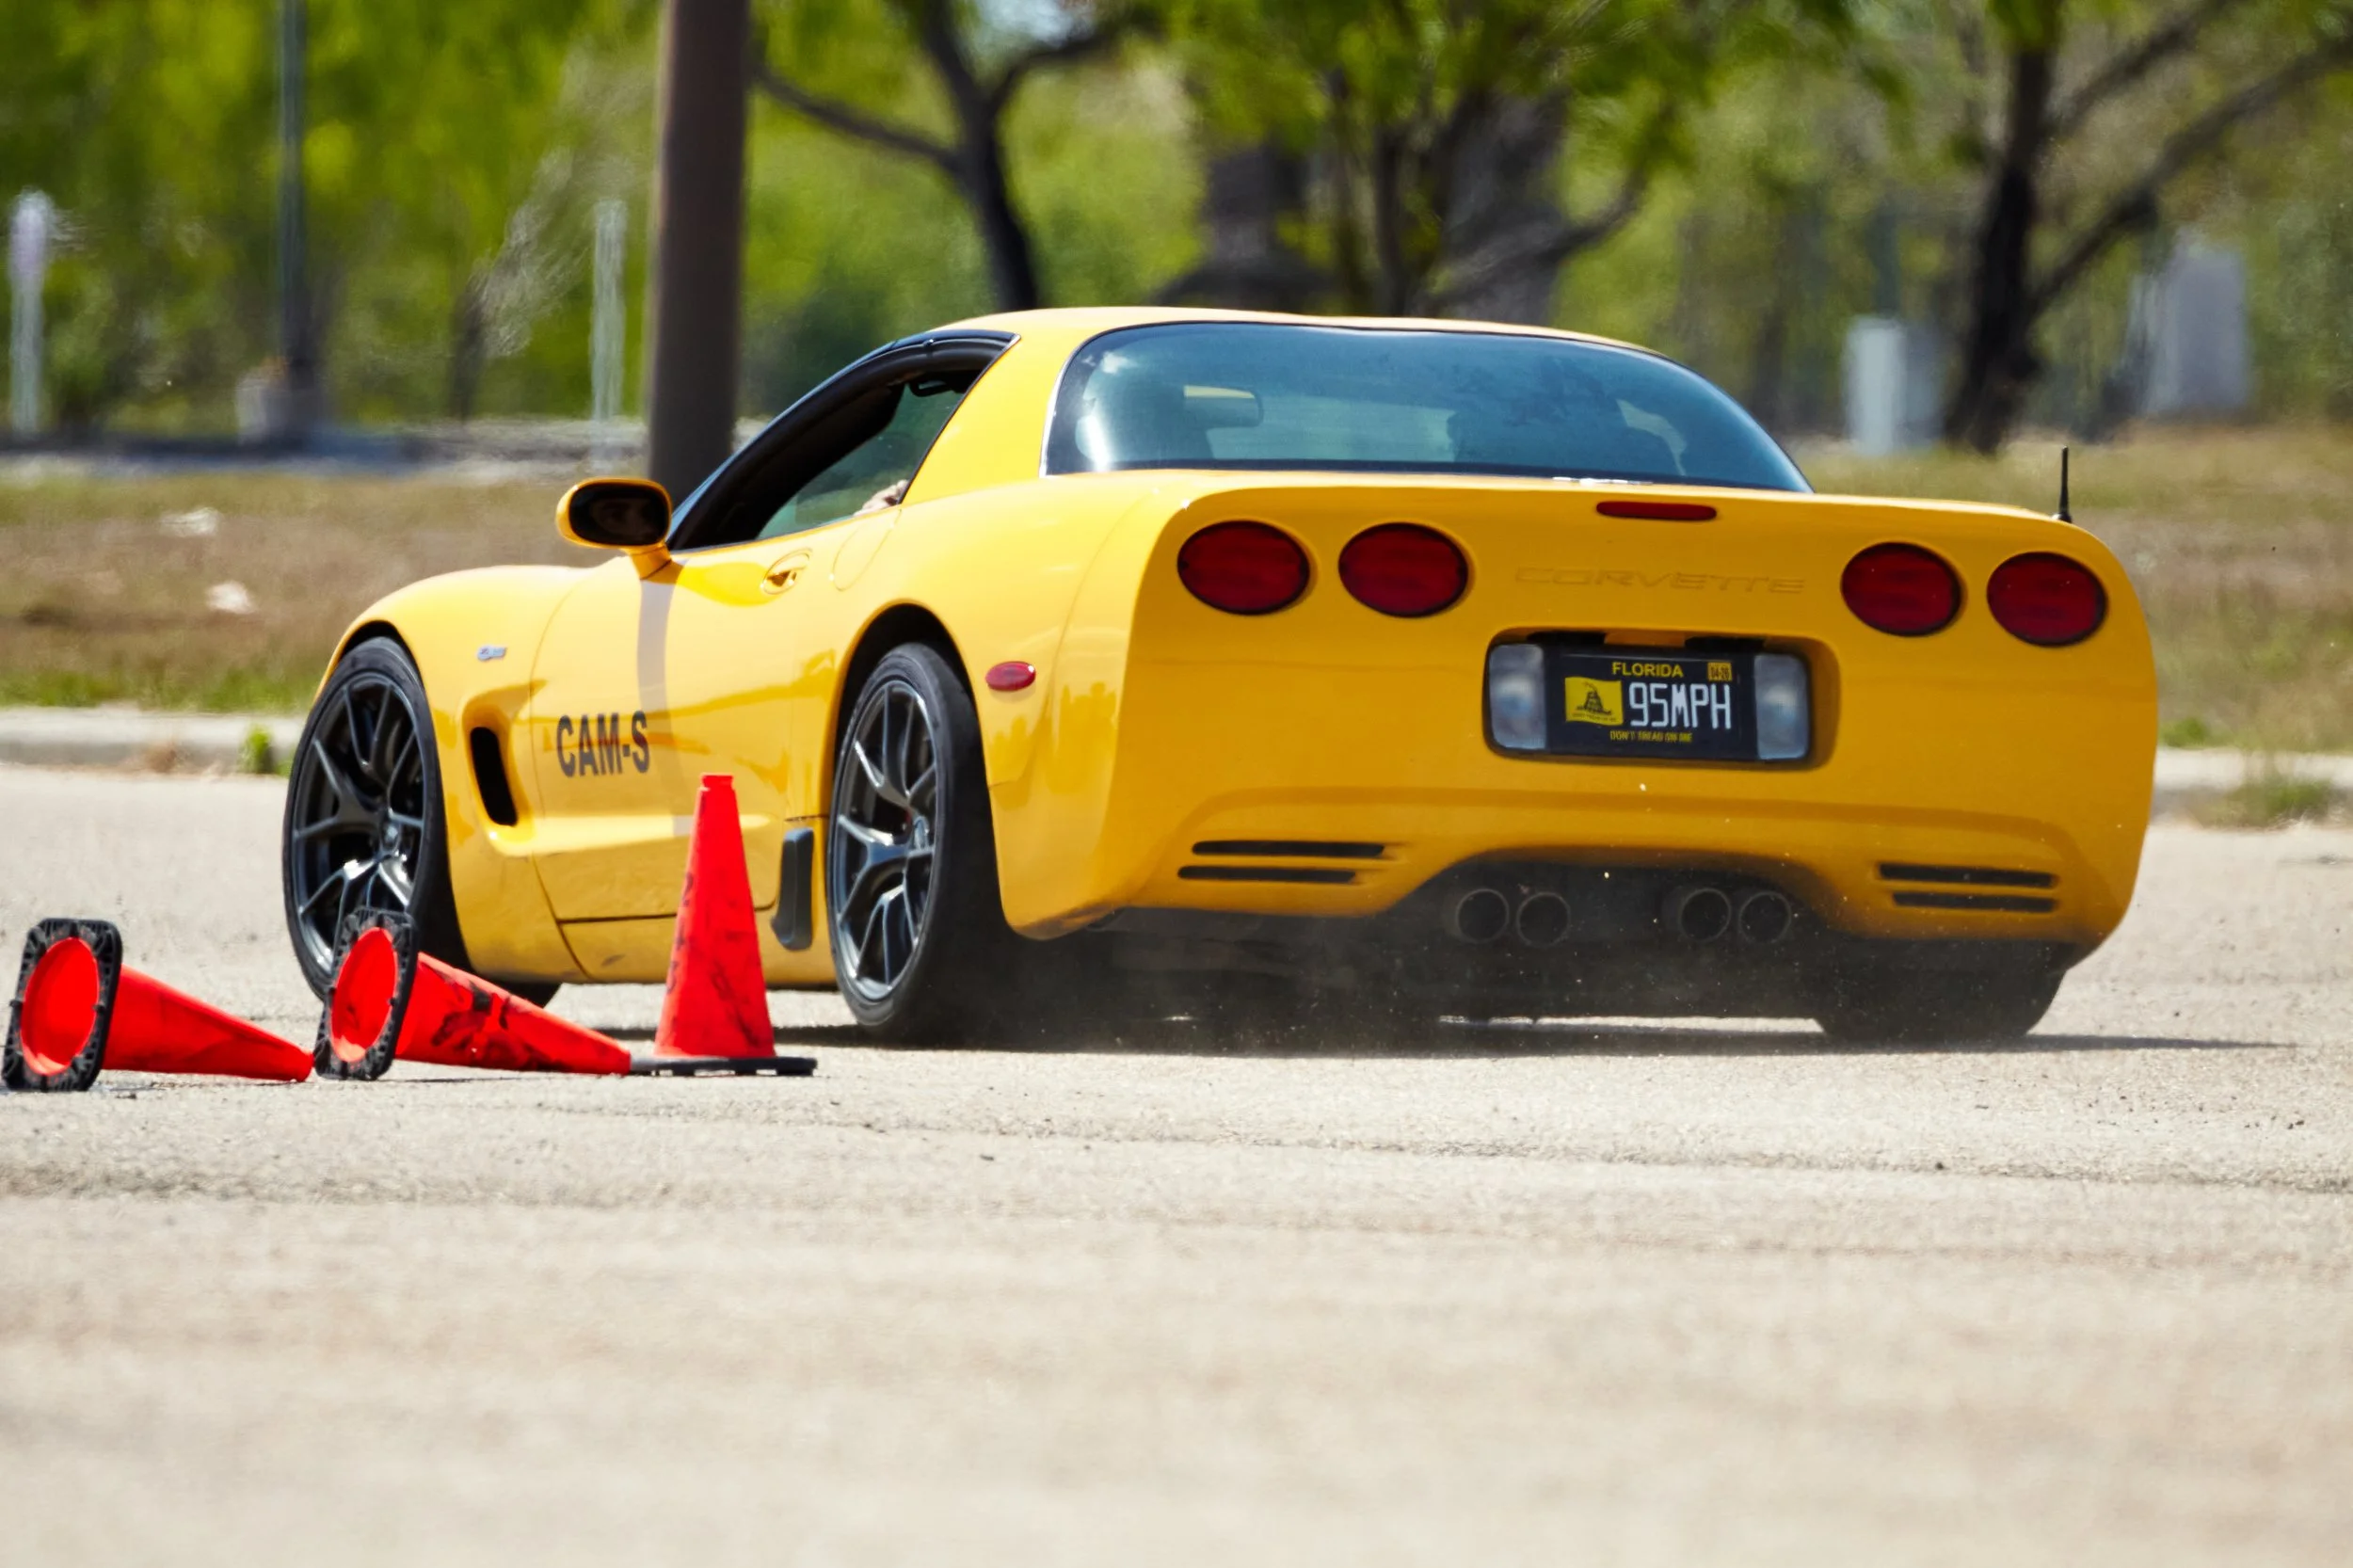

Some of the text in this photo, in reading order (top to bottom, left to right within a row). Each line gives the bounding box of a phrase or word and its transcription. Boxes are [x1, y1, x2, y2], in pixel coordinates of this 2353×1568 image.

[1515, 567, 1806, 594] CORVETTE
[1611, 661, 1684, 679] FLORIDA
[1628, 681, 1732, 729] 95MPH
[556, 710, 650, 777] CAM-S
